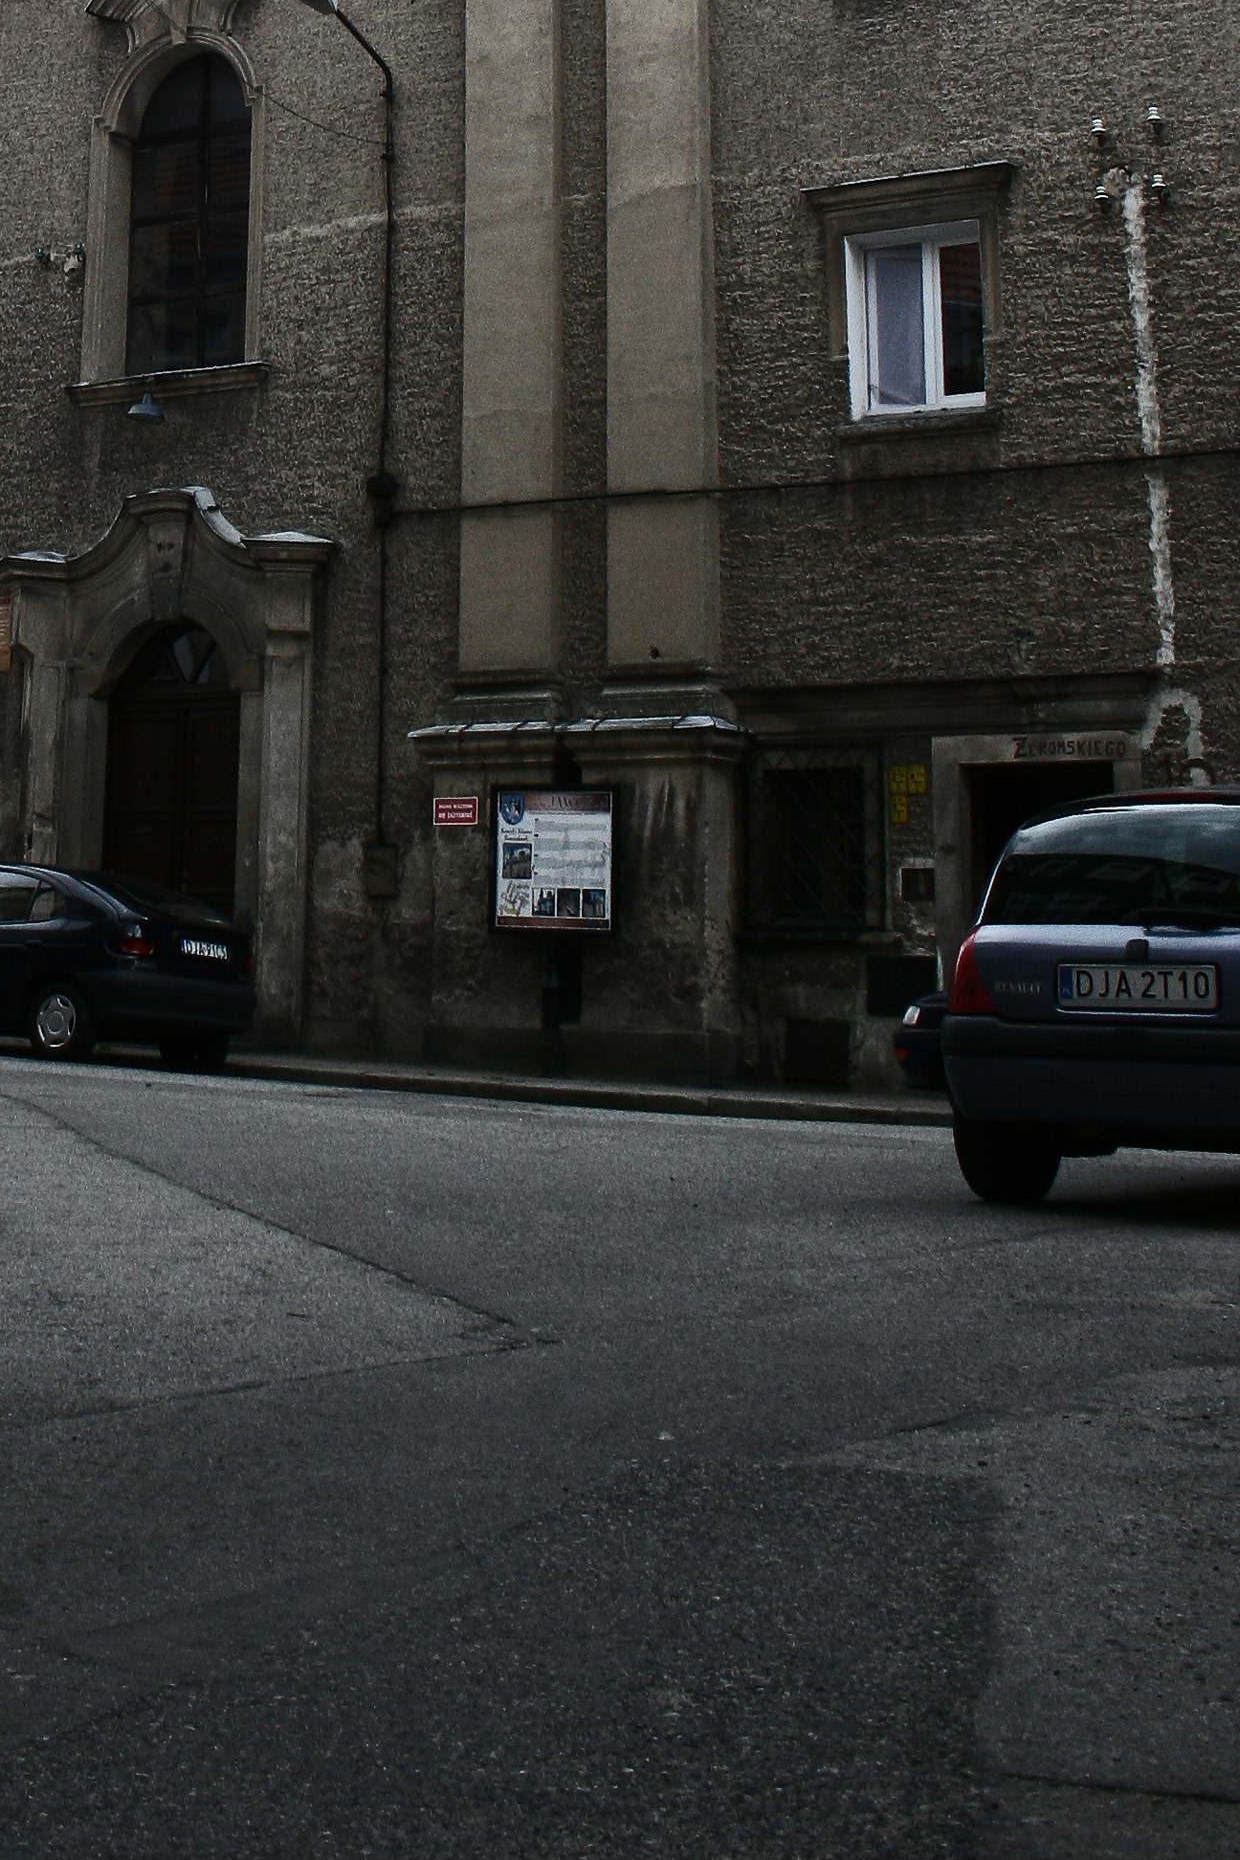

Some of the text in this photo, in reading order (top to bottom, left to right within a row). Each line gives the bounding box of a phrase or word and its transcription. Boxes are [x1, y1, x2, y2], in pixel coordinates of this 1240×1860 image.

[995, 980, 1042, 994] RENAULT
[1076, 969, 1210, 999] DJA 2T10
